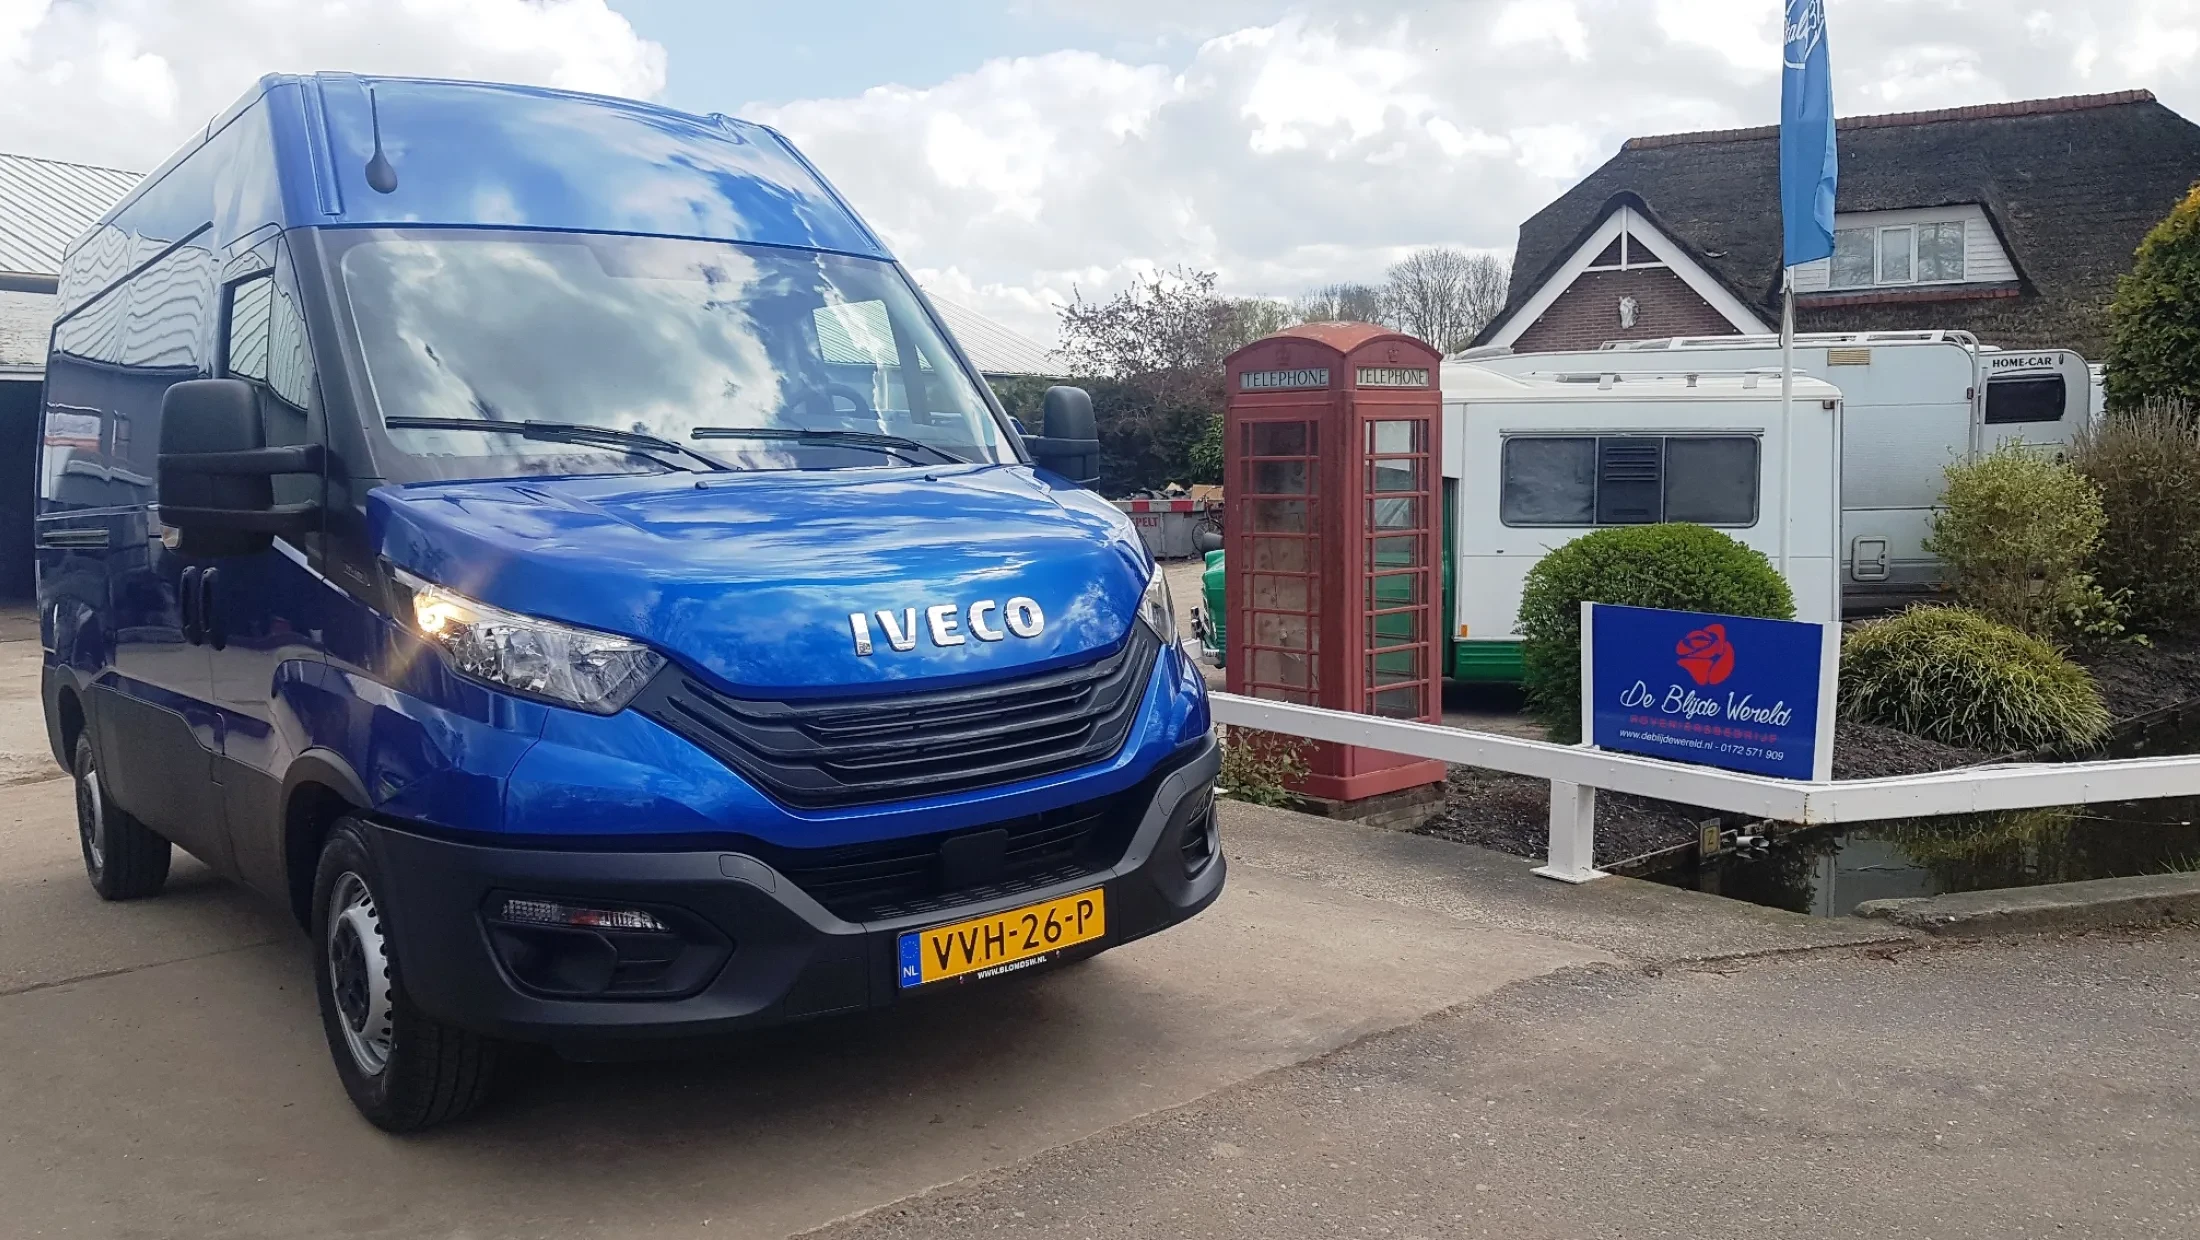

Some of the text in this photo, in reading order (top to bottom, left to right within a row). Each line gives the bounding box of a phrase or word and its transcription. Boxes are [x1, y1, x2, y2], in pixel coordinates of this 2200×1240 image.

[1992, 356, 2052, 368] HOME-CAR
[1243, 369, 1327, 388] TELEPHONE
[1358, 367, 1426, 385] TELEPHONE
[1131, 516, 1159, 528] PELT
[848, 596, 1045, 657] IVECO
[1619, 680, 1792, 727] De Blijde Wereld
[1619, 728, 1713, 750] www.deblijdewereld.nl
[1720, 743, 1744, 755] 0172
[1745, 747, 1763, 757] 571
[1765, 750, 1784, 761] 909
[932, 899, 1094, 971] VVH-26-P
[903, 965, 919, 978] NL
